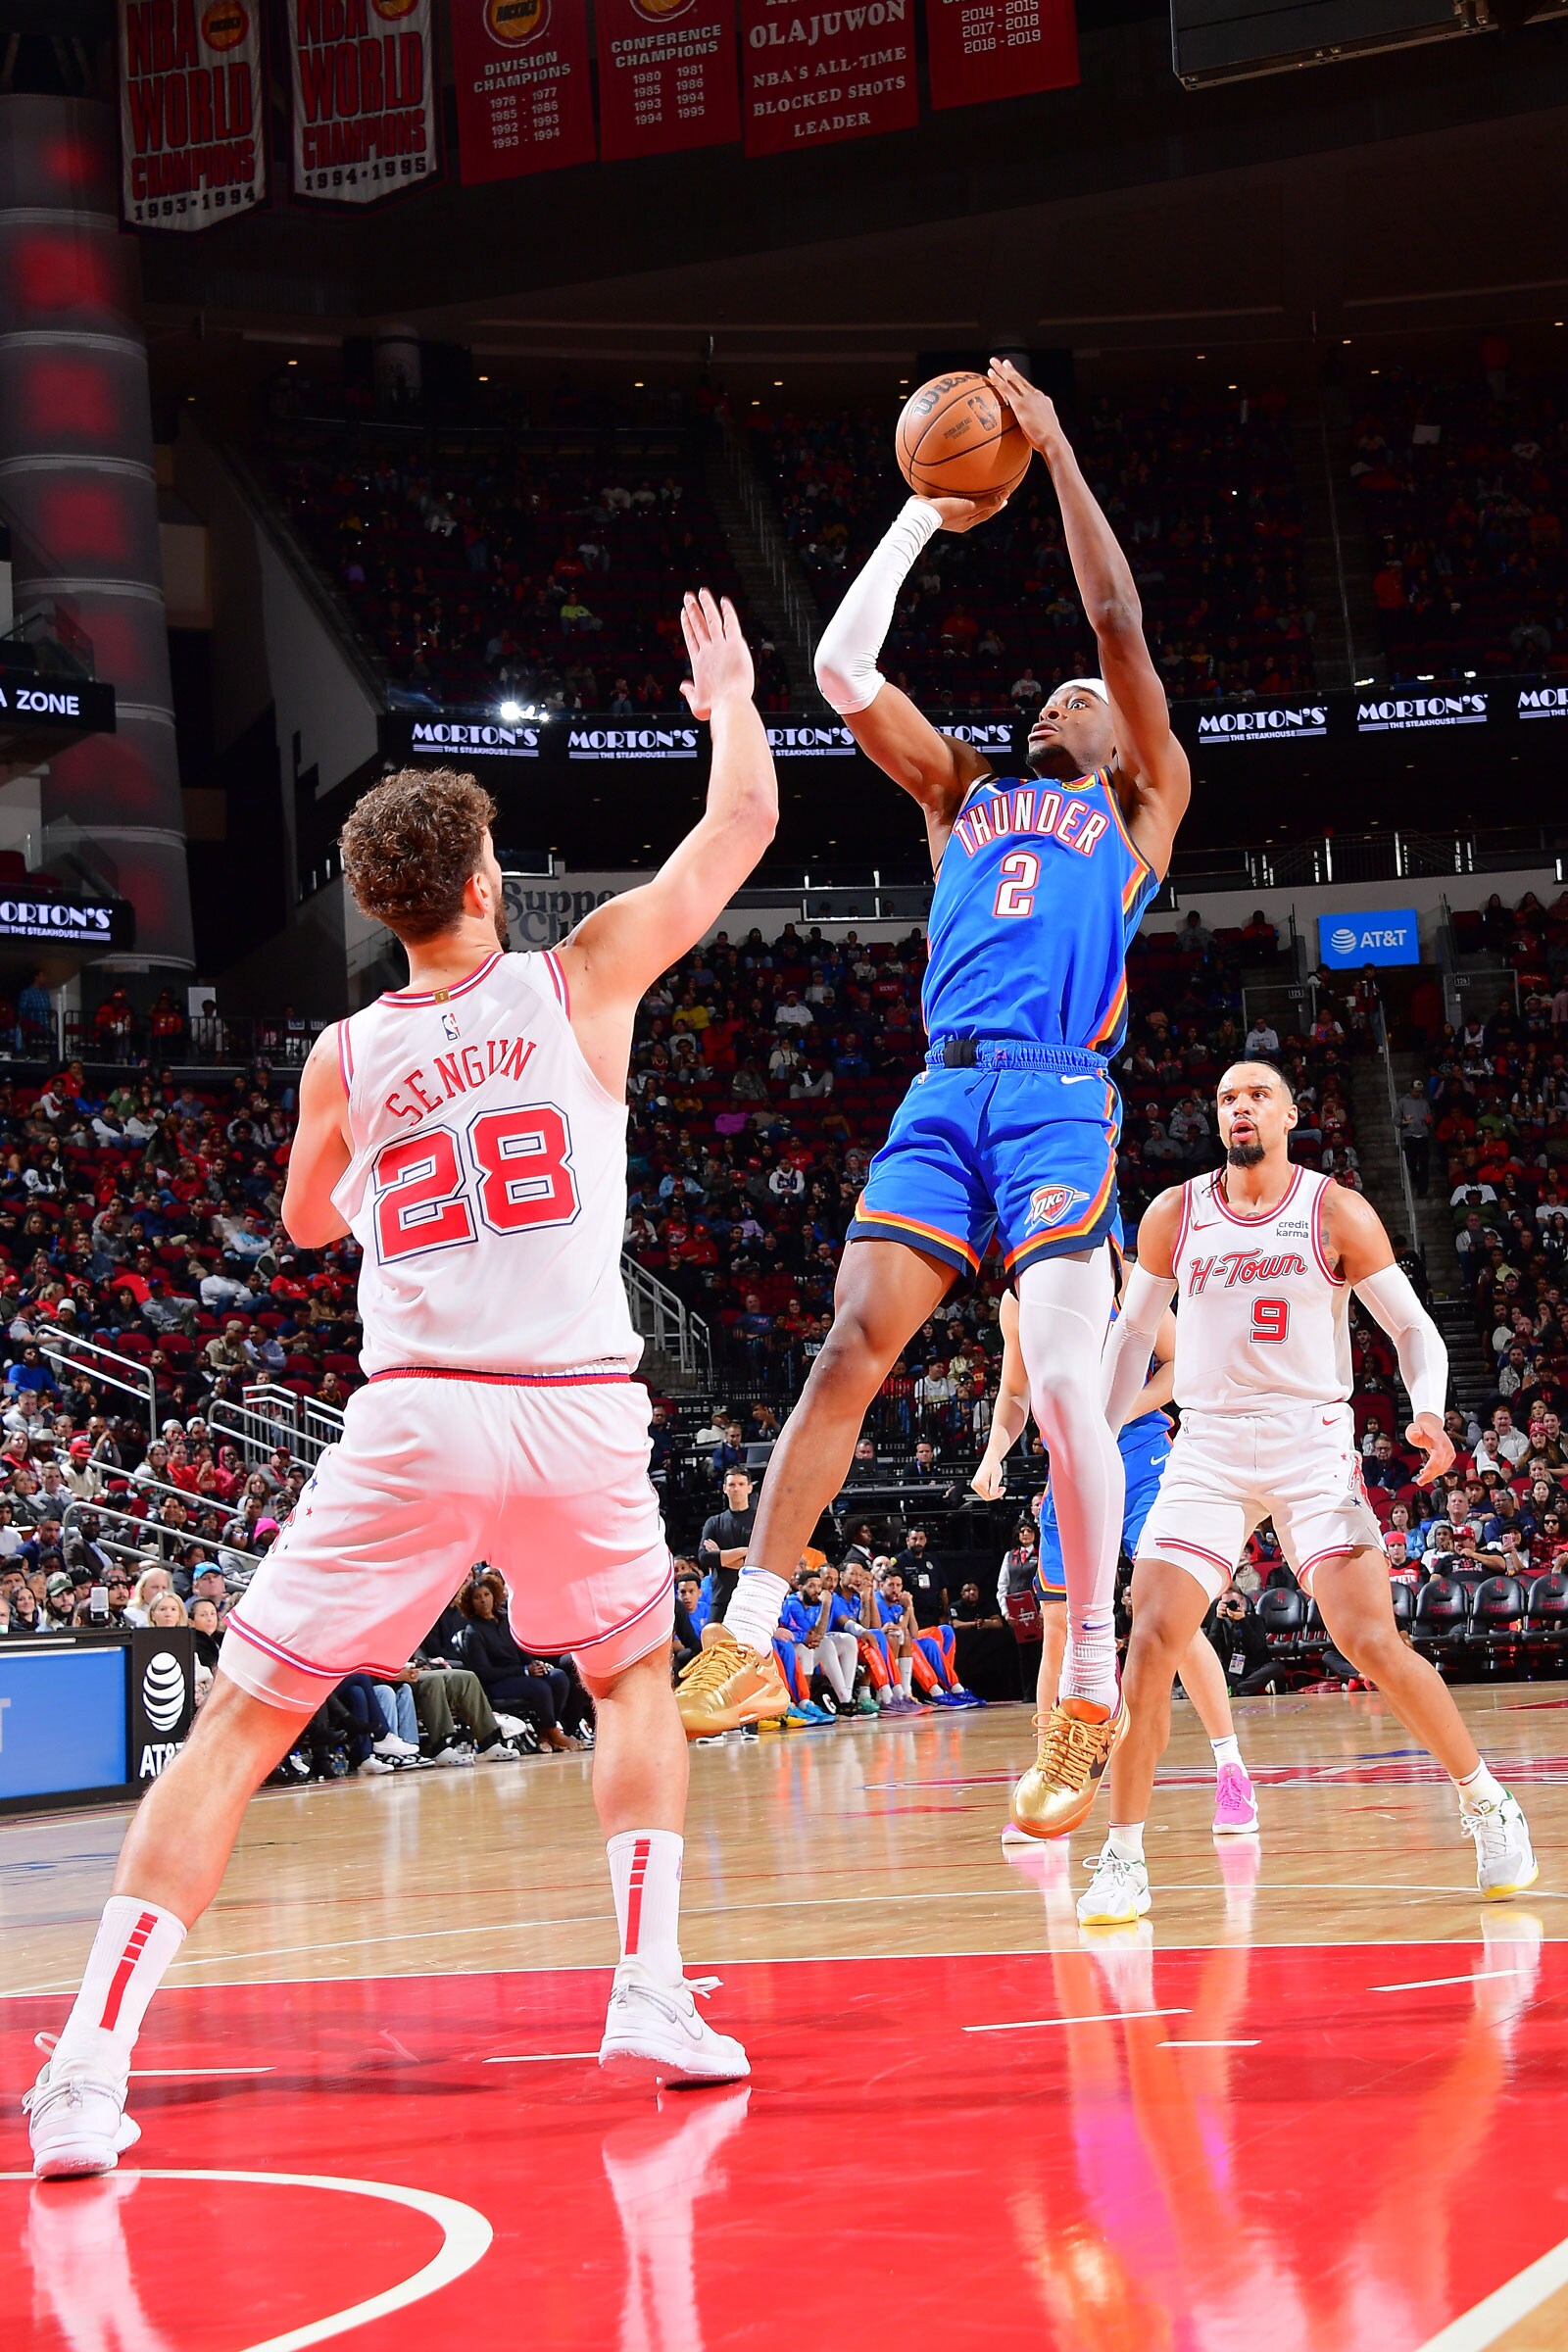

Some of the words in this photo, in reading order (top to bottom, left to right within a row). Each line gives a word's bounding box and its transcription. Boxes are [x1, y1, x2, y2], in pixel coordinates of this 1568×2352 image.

[749, 0, 906, 48] OLAJUWON
[960, 6, 994, 23] 2014
[1004, 0, 1039, 15] 2015
[126, 0, 199, 77] NBA
[962, 22, 995, 38] 2017
[1005, 14, 1039, 30] 2018
[611, 24, 721, 54] CONFERENCE
[963, 37, 997, 54] 2018
[1006, 29, 1041, 46] 2019
[484, 51, 558, 76] DIVISION
[615, 41, 718, 69] CHAMPIONS
[753, 66, 808, 88] NBA'S
[814, 46, 906, 77] ALL-TIME
[298, 31, 423, 123] WORLD
[473, 63, 571, 93] CHAMPIONS
[633, 71, 662, 85] 1980
[676, 64, 704, 78] 1981
[489, 95, 516, 109] 1976
[532, 87, 557, 102] 1977
[633, 84, 662, 99] 1985
[676, 78, 704, 92] 1986
[753, 87, 842, 117] BLOCKED
[848, 75, 906, 99] SHOTS
[127, 61, 253, 154] WORLD
[490, 108, 517, 122] 1985
[531, 100, 559, 116] 1986
[634, 98, 662, 112] 1993
[676, 91, 705, 106] 1994
[492, 122, 518, 136] 1992
[532, 114, 560, 128] 1993
[635, 112, 662, 125] 1994
[677, 105, 705, 119] 1995
[794, 112, 871, 137] LEADER
[303, 108, 427, 172] CHAMPIONS
[493, 135, 518, 149] 1993
[533, 126, 560, 142] 1994
[131, 138, 256, 201] CHAMPIONS
[16, 689, 80, 715] ZONE
[1357, 695, 1487, 721] MORTON'S
[1199, 708, 1326, 733] MORTON'S
[1405, 717, 1456, 727] STEAKHOUSE
[413, 723, 539, 747] MORTON'S
[568, 729, 697, 749] MORTON'S
[766, 728, 855, 746] RTON'S
[1246, 730, 1296, 740] STEAKHOUSE
[460, 746, 509, 756] STEAKHOUSE
[953, 789, 1109, 858] THUNDER
[992, 850, 1041, 918] 2
[503, 882, 625, 923] Suppe
[0, 902, 112, 929] ORTON'S
[10, 925, 26, 934] THE
[27, 926, 79, 939] STEAKHOUSE
[1360, 929, 1406, 949] AT&T
[385, 1037, 537, 1127] SENGUN
[372, 1102, 582, 1266] 28
[1033, 1190, 1064, 1220] OKC
[1276, 1228, 1309, 1239] karma
[1278, 1220, 1309, 1230] credit
[1188, 1248, 1308, 1297] H-Town
[1250, 1297, 1291, 1344] 9
[139, 1742, 185, 1779] AT&
